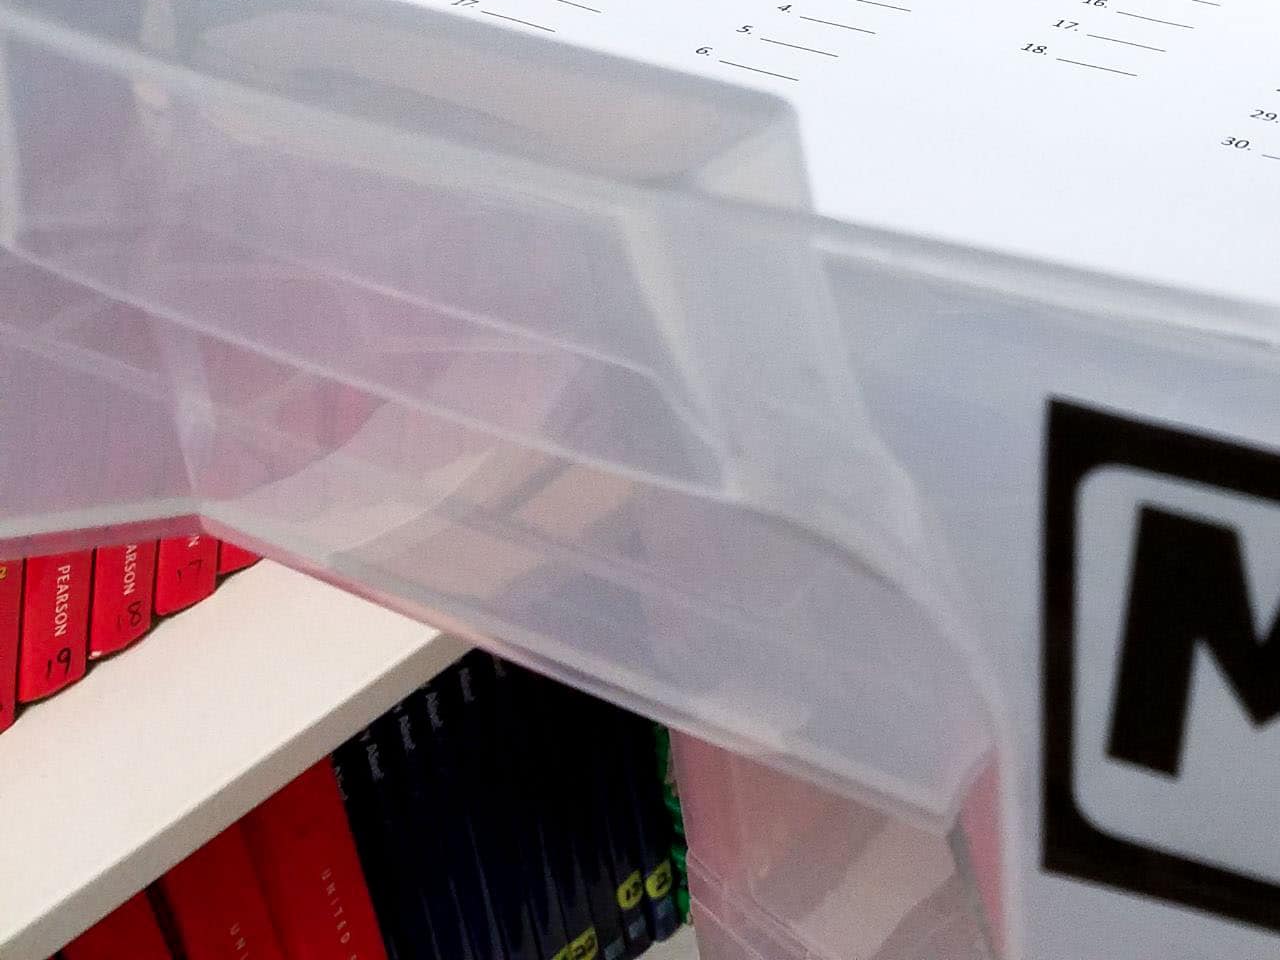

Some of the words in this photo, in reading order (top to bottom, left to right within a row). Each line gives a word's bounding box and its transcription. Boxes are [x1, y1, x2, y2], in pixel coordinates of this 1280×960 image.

[777, 3, 792, 13] 4.
[736, 24, 753, 35] 5.
[1052, 19, 1079, 32] 17.
[695, 46, 712, 57] 6.
[1021, 42, 1048, 56] 18.
[1249, 109, 1279, 123] 29.
[1220, 136, 1251, 151] 30.
[123, 544, 137, 595] ARSON
[54, 564, 71, 637] PEARSON
[47, 647, 72, 680] 19
